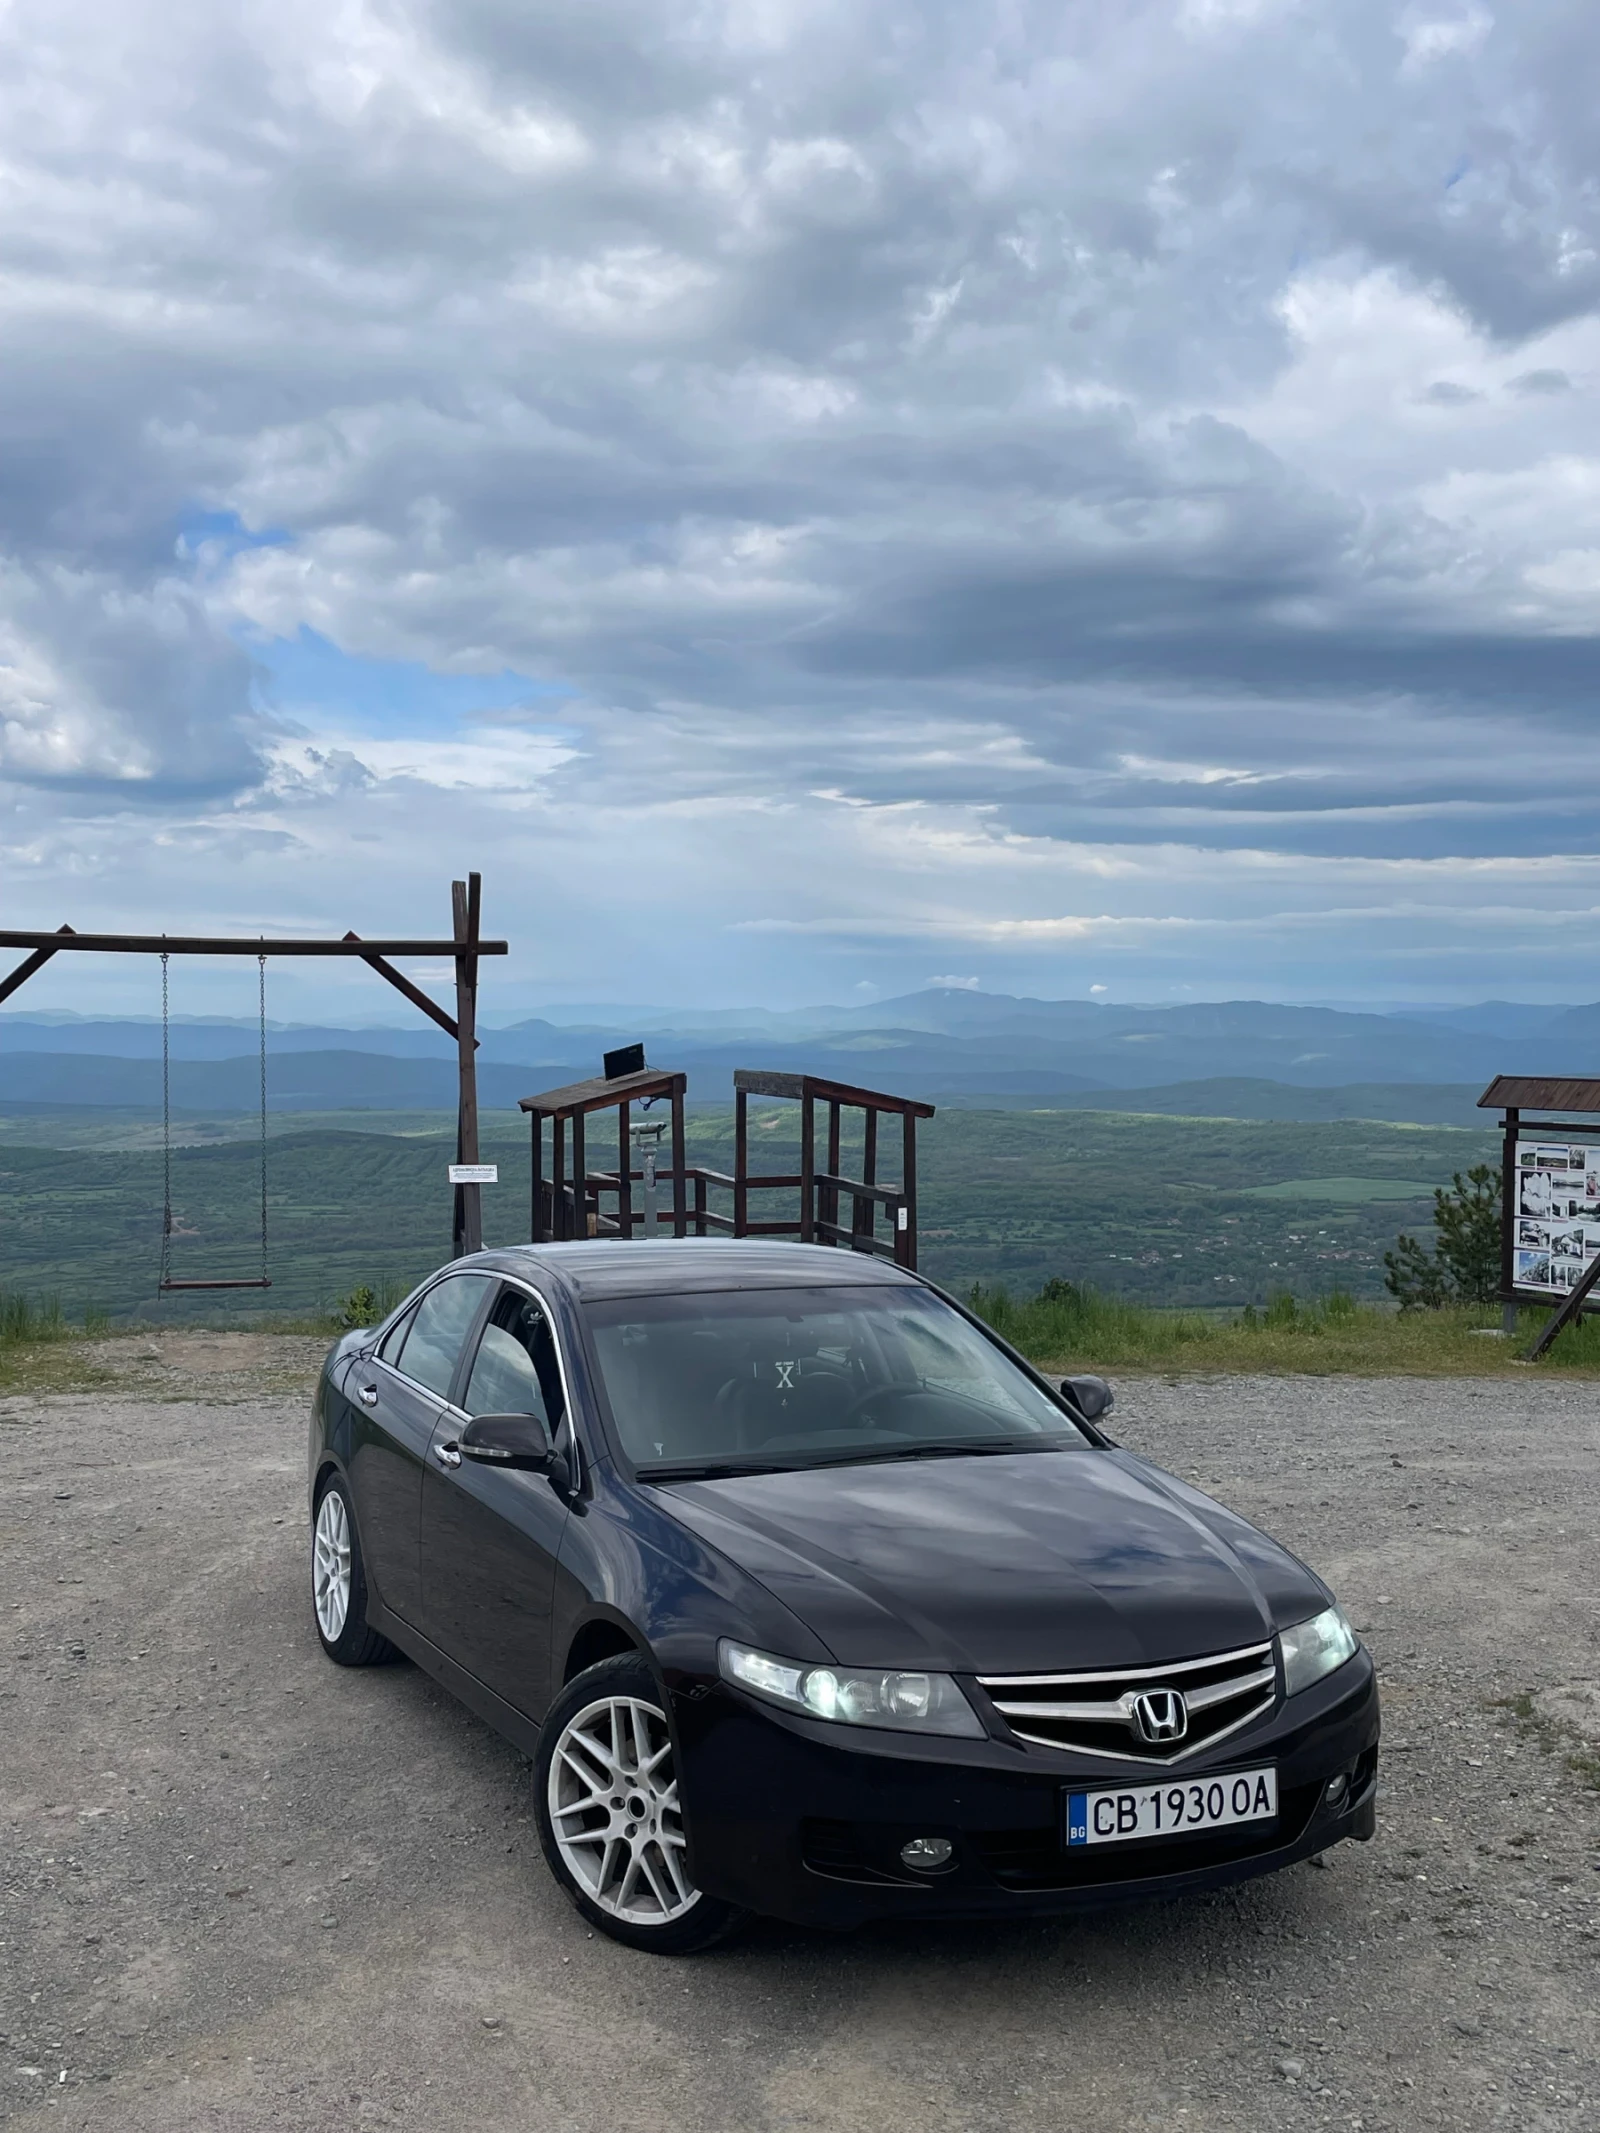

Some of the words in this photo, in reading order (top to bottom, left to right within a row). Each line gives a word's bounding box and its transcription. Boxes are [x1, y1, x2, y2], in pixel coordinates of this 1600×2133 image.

[1093, 1794, 1138, 1836] CB
[1150, 1783, 1224, 1829] 1930
[1231, 1775, 1270, 1816] OA
[1070, 1826, 1086, 1839] BG
